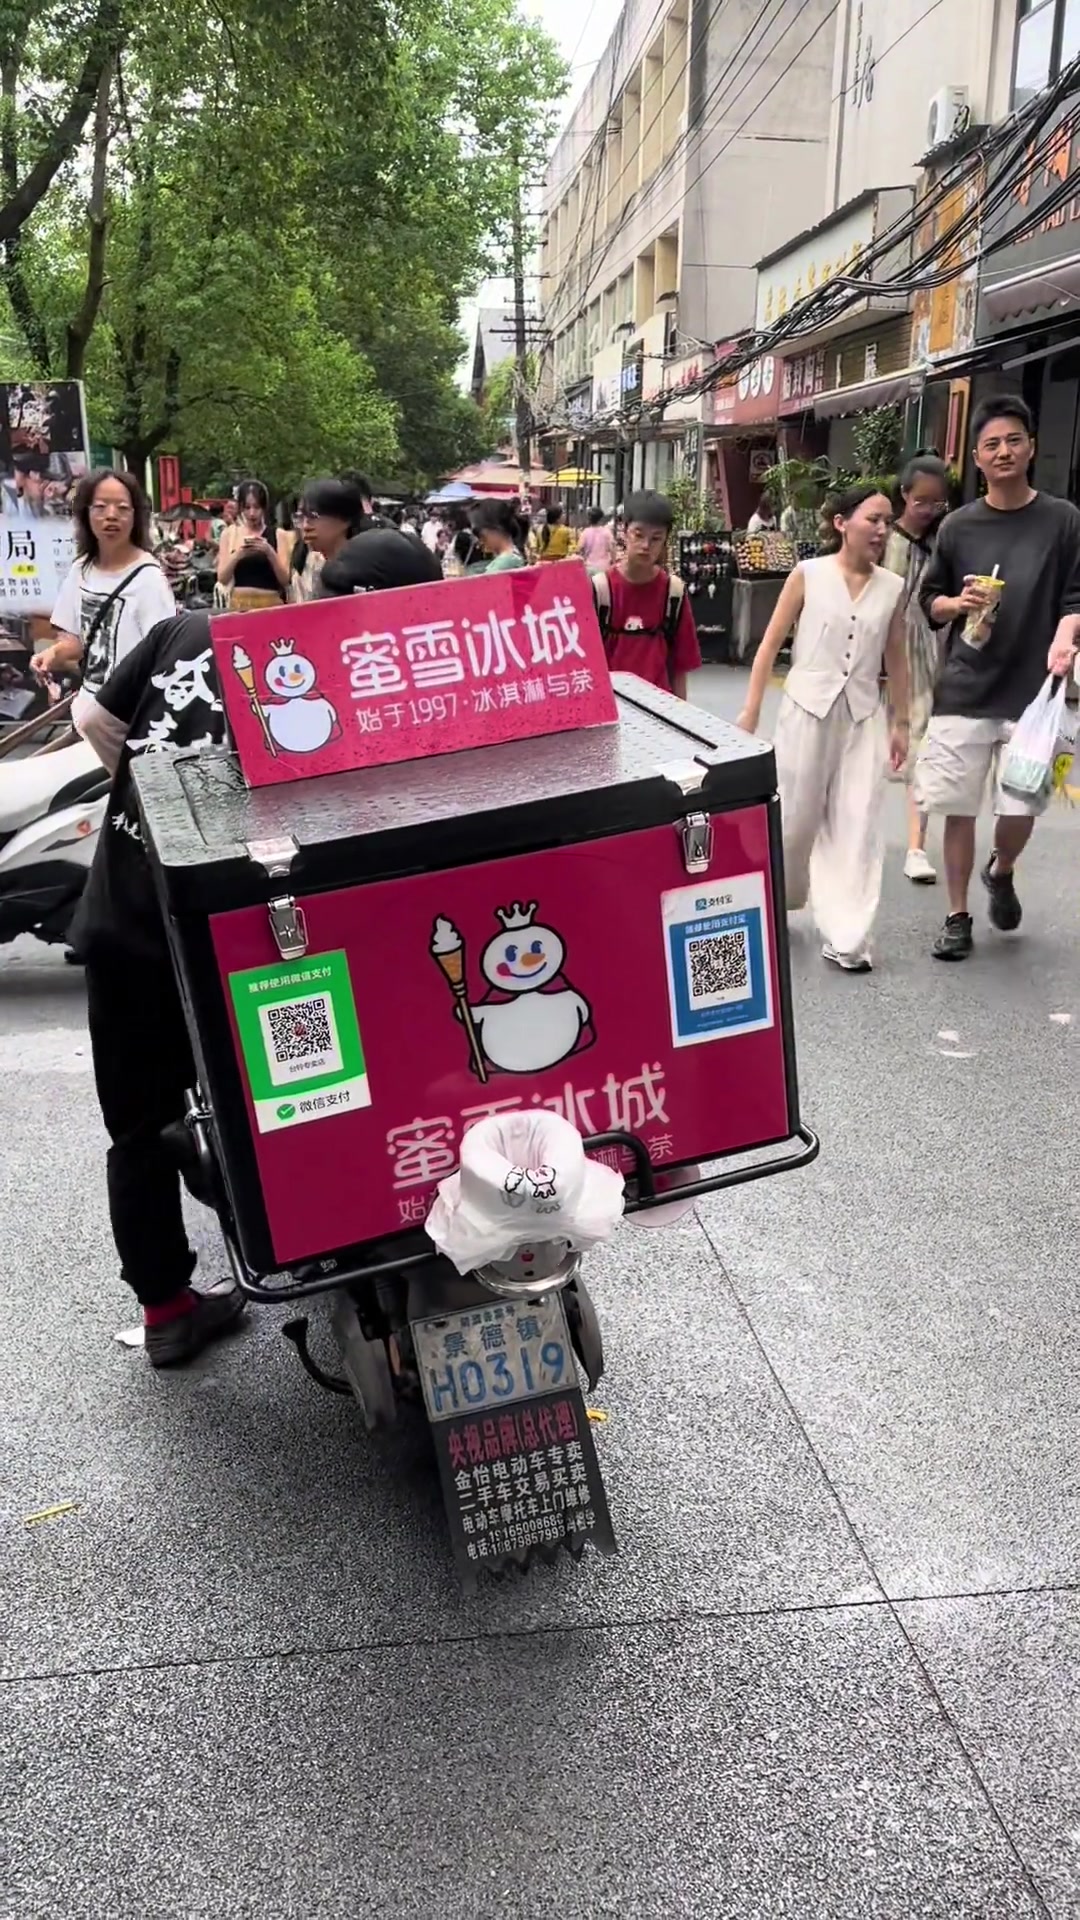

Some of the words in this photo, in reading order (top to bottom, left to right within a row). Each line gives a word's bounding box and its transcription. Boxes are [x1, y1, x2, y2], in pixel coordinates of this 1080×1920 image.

[0, 530, 35, 561] 局
[340, 596, 586, 699] 蜜雪冰城
[707, 894, 733, 908] 支付宝
[248, 966, 332, 993] 推荐使用微信支付
[299, 1090, 351, 1114] 微信支付
[443, 1315, 542, 1359] 景德镇
[429, 1342, 564, 1412] H0319
[449, 1401, 579, 1469] 央视品牌(总代理)
[454, 1441, 584, 1492] 金怡电动车专卖
[458, 1464, 588, 1511] 二手车交易买卖
[462, 1486, 592, 1534] 电动车摩托车上门维修
